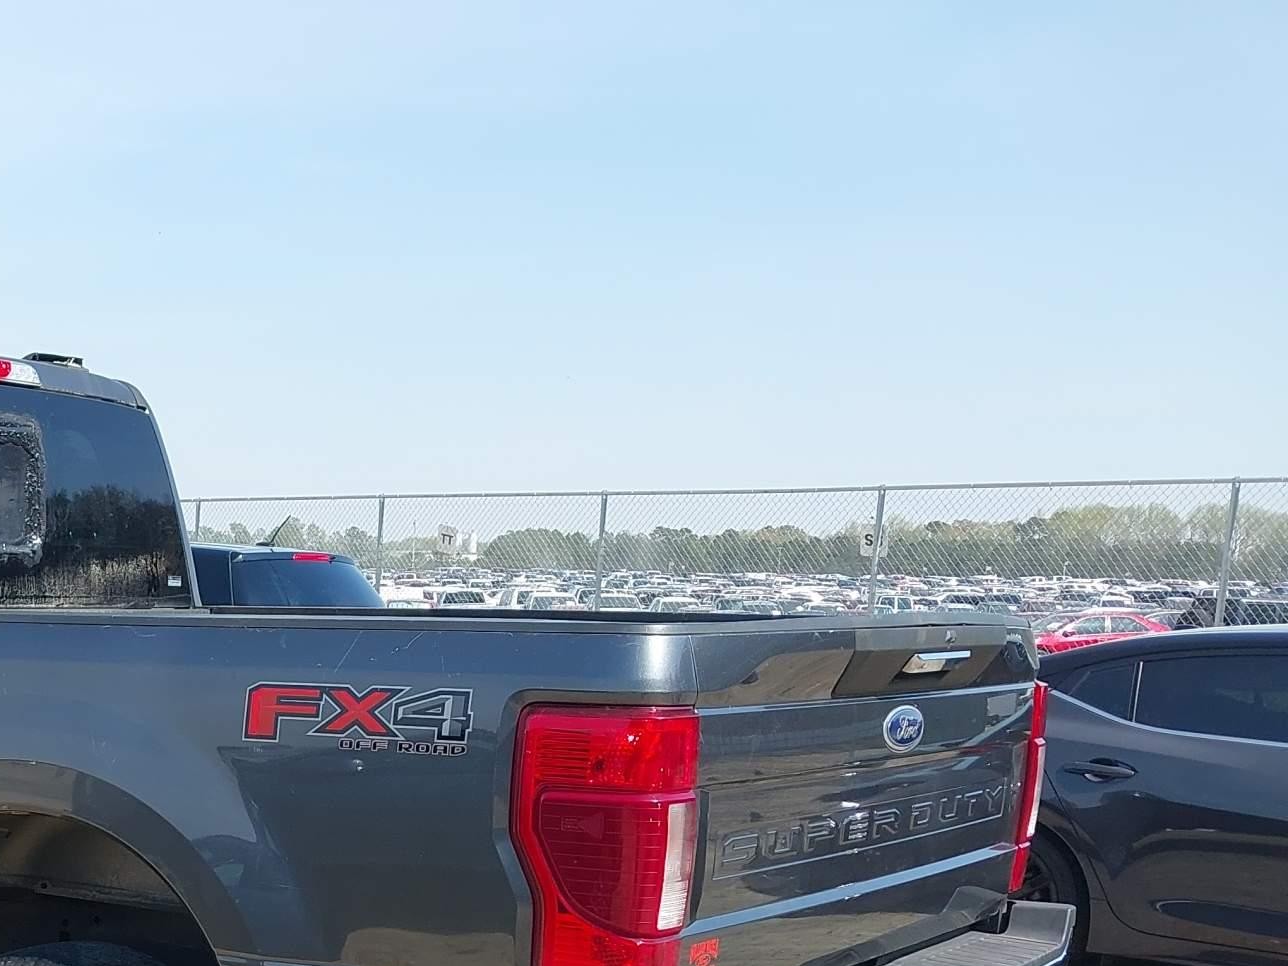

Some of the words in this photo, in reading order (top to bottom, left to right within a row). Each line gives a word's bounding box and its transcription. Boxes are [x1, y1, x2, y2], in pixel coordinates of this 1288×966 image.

[242, 681, 473, 743] FX4
[338, 738, 389, 752] OFF
[397, 741, 467, 757] ROAD
[721, 808, 902, 864] SUPER
[909, 786, 1003, 830] DUTY
